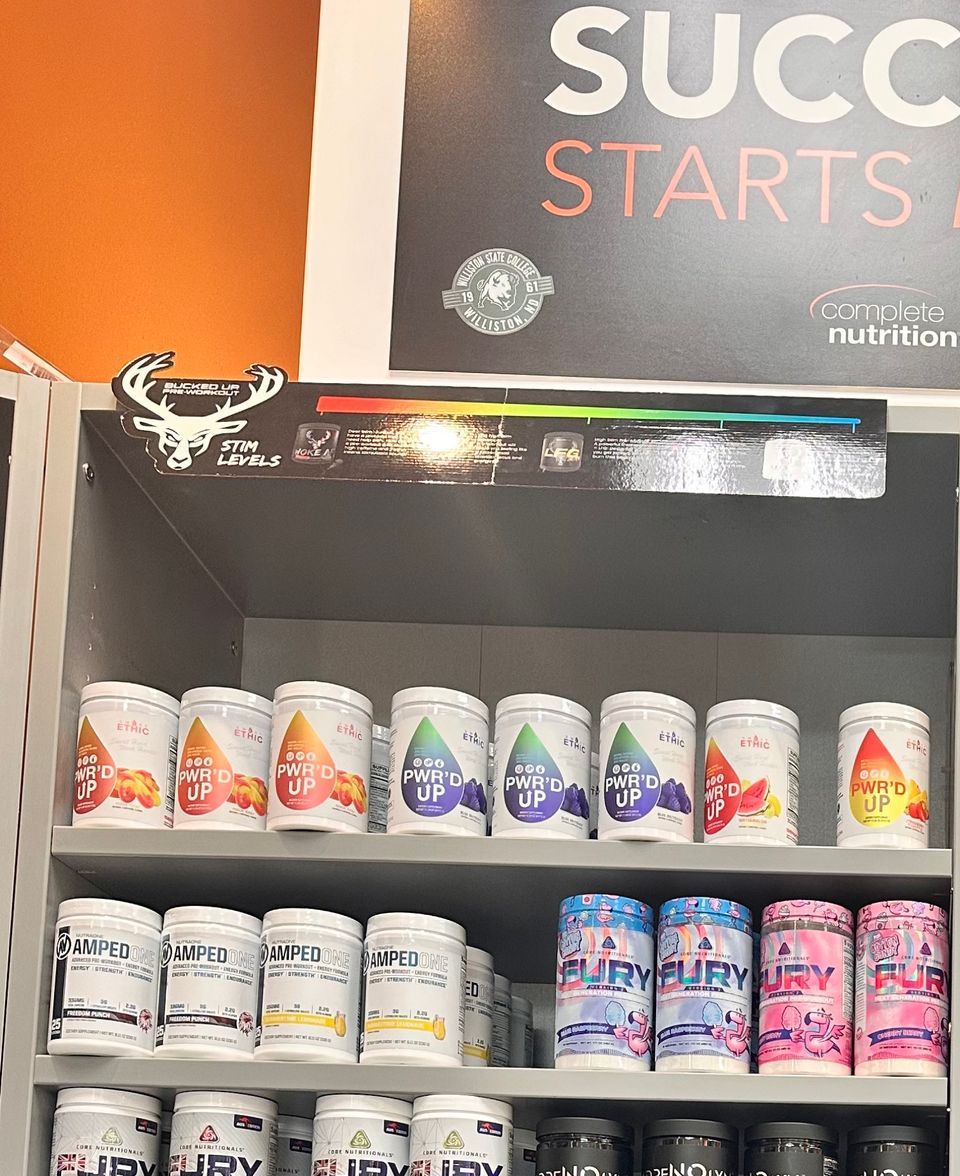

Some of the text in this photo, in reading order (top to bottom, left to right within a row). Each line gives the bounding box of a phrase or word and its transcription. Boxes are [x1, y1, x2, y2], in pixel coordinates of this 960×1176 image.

[541, 140, 914, 228] STARTS
[456, 251, 536, 287] WILLISTON STATE COLLEGE
[461, 281, 539, 303] 19 61
[821, 300, 945, 326] complete
[828, 324, 958, 347] nutrition
[164, 382, 241, 391] BUCKED UP
[220, 439, 259, 454] STIM
[216, 454, 282, 468] LEVELS
[179, 769, 232, 786] PWR'D
[277, 763, 334, 780] PWR'D
[403, 769, 463, 787] PWR'D
[187, 783, 213, 801] UP
[288, 777, 316, 796] UP
[505, 775, 563, 793] PWR'D
[605, 774, 659, 792] PWR'D
[851, 780, 906, 797] PWR'D
[417, 784, 445, 803] UP
[518, 790, 547, 809] UP
[616, 790, 642, 808] UP
[864, 795, 891, 813] UP
[562, 958, 651, 991] FURY
[661, 958, 748, 991] FURY
